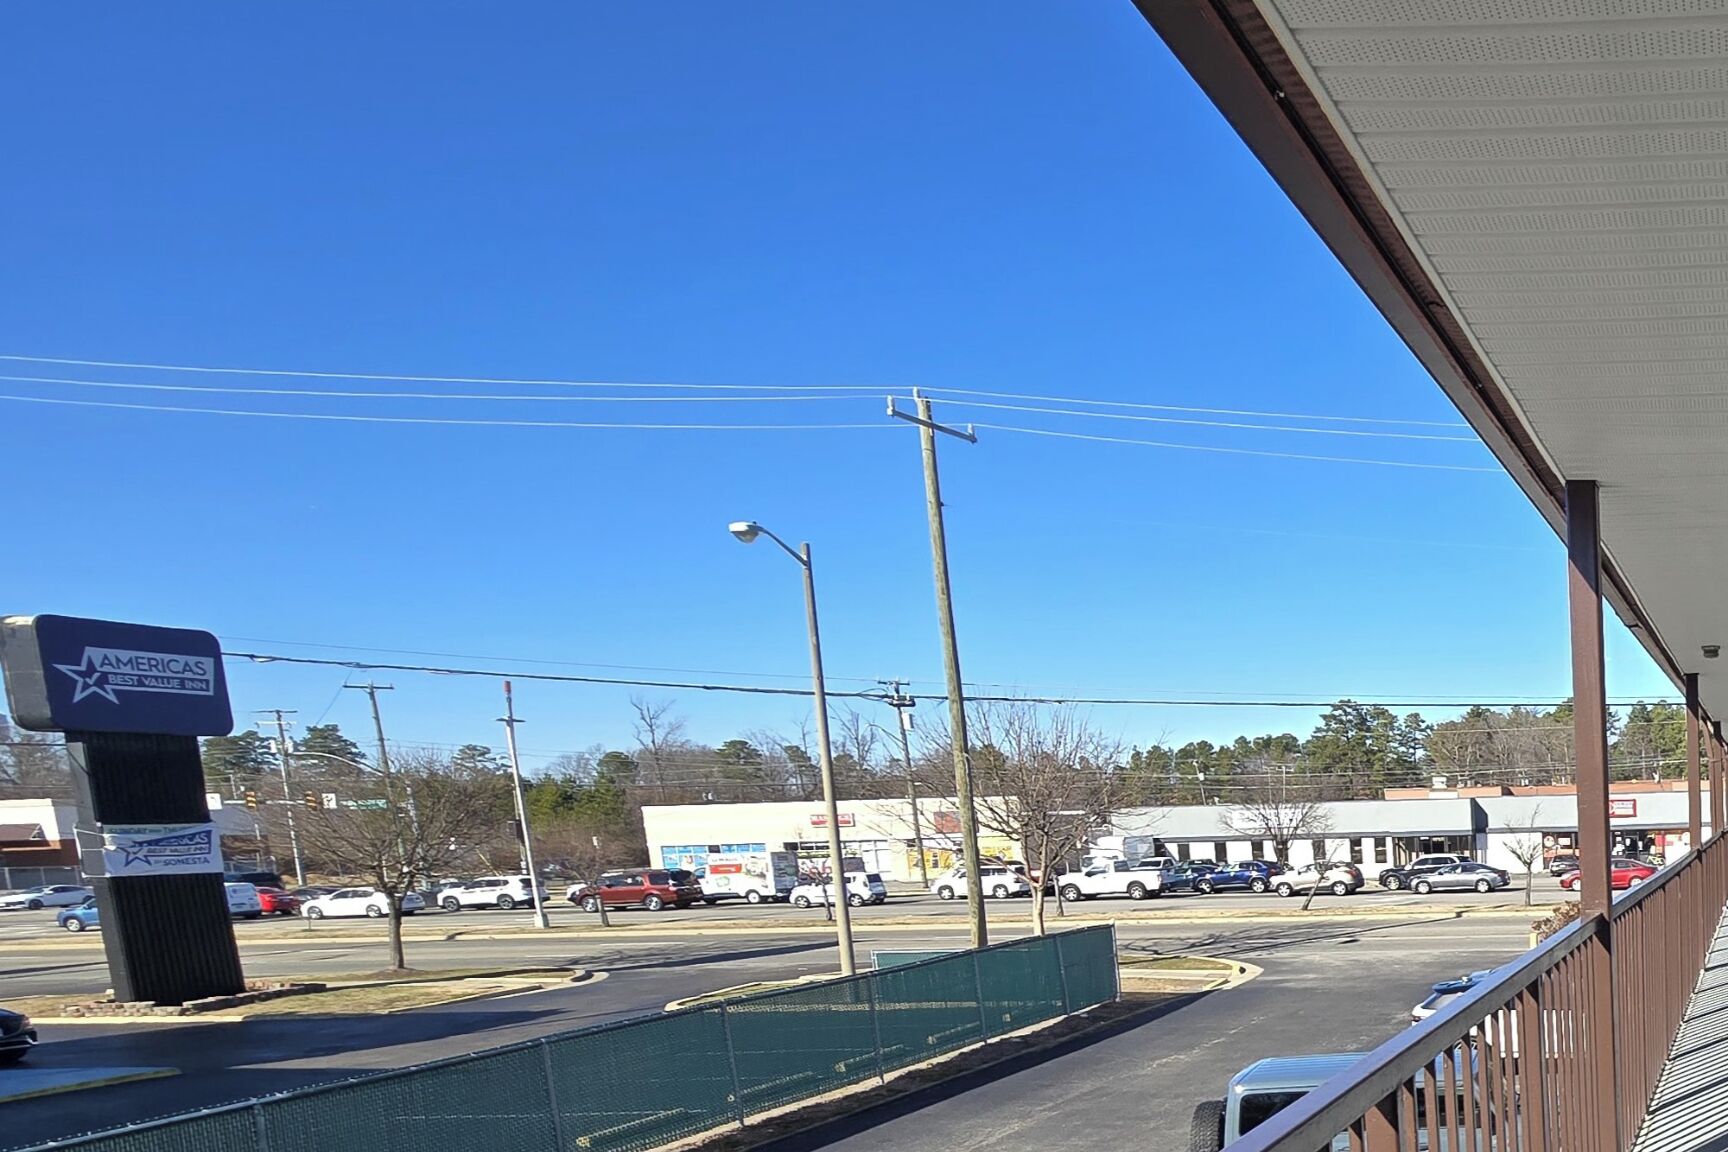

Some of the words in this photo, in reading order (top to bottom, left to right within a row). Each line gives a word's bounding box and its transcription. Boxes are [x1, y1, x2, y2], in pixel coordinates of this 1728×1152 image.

[101, 653, 206, 676] AMERICAS
[108, 674, 139, 685] BEST
[142, 677, 181, 688] VALUE
[185, 680, 207, 689] INN
